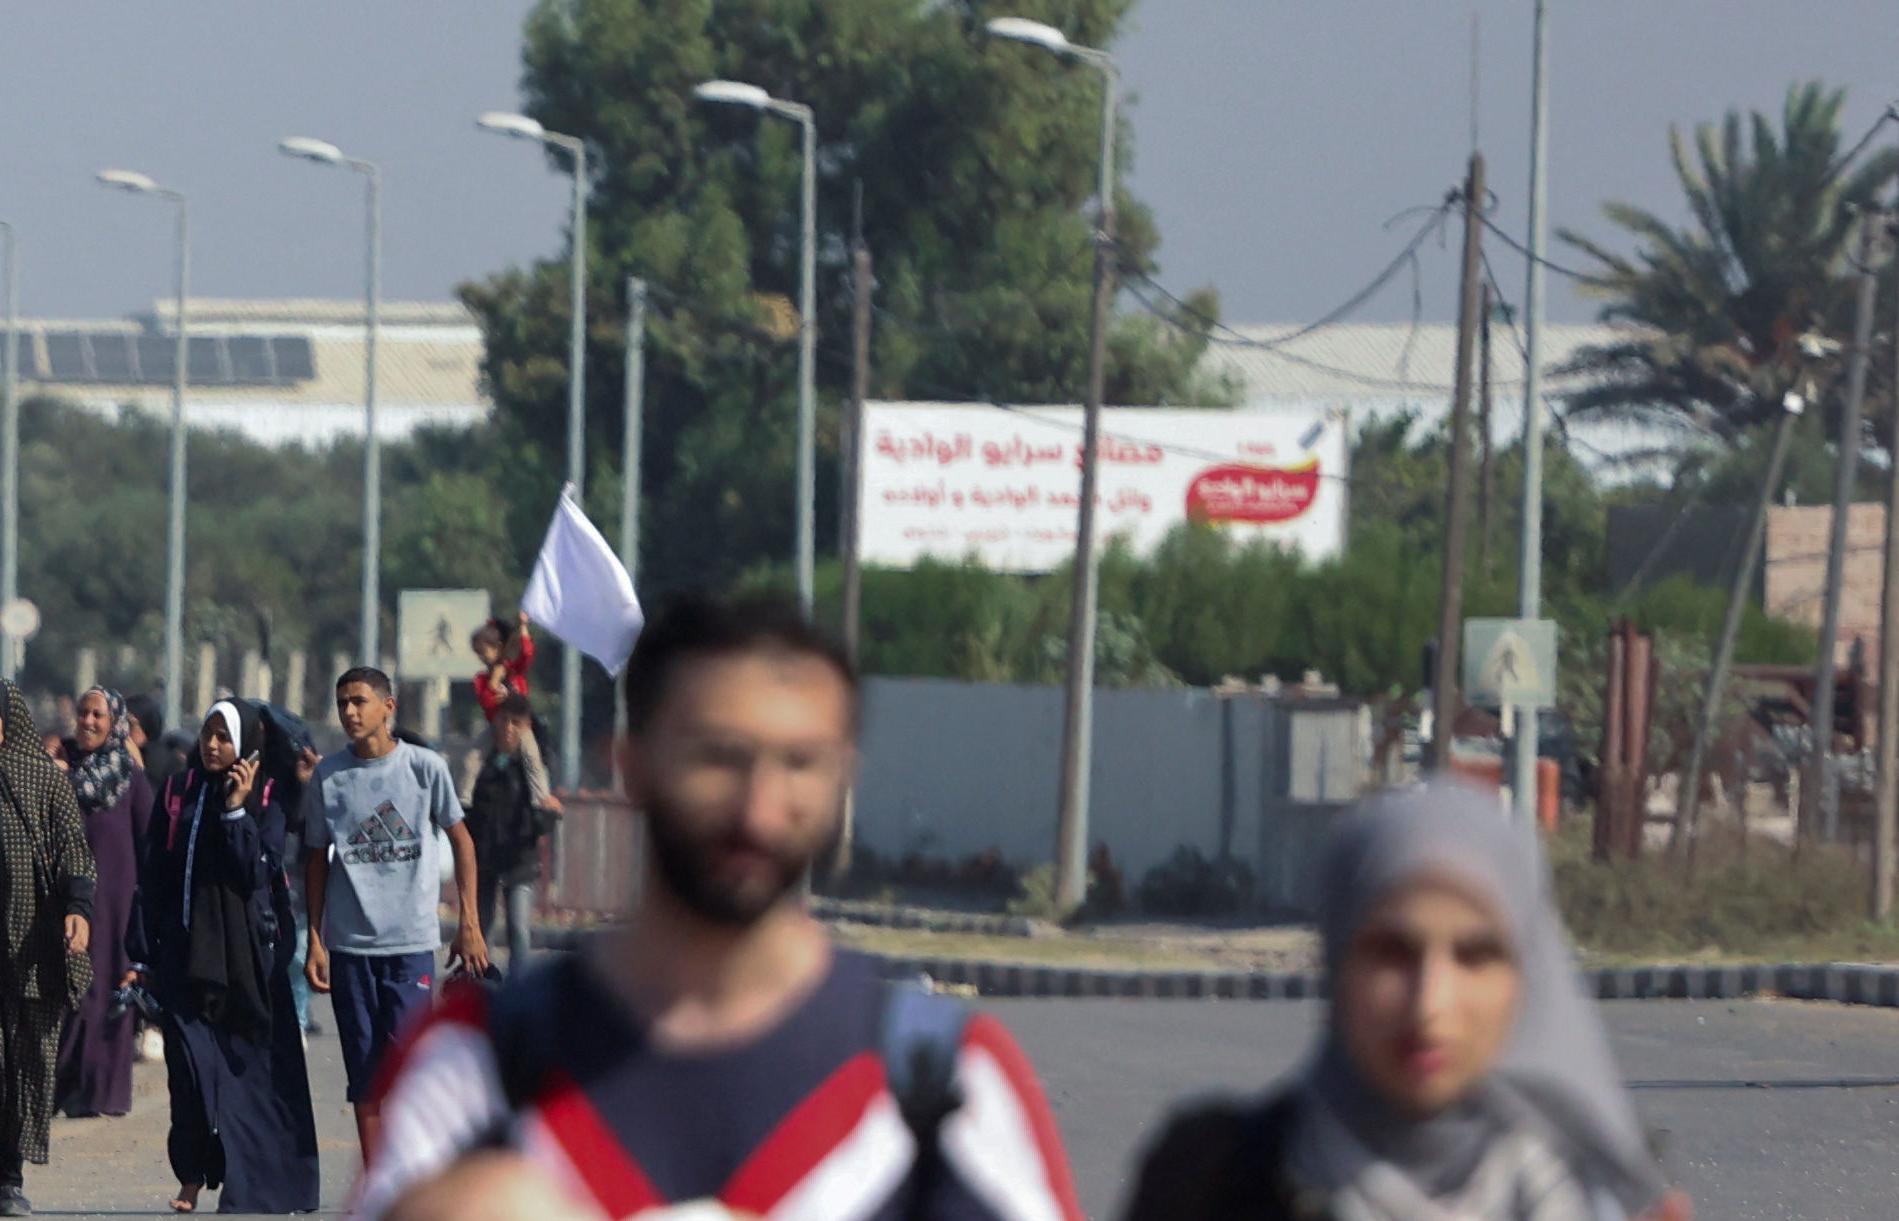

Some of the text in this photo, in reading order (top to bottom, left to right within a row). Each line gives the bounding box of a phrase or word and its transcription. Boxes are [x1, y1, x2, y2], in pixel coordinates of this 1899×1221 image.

[876, 432, 970, 464] الوادية
[983, 434, 1062, 467] سرايو
[344, 843, 421, 863] adidas
